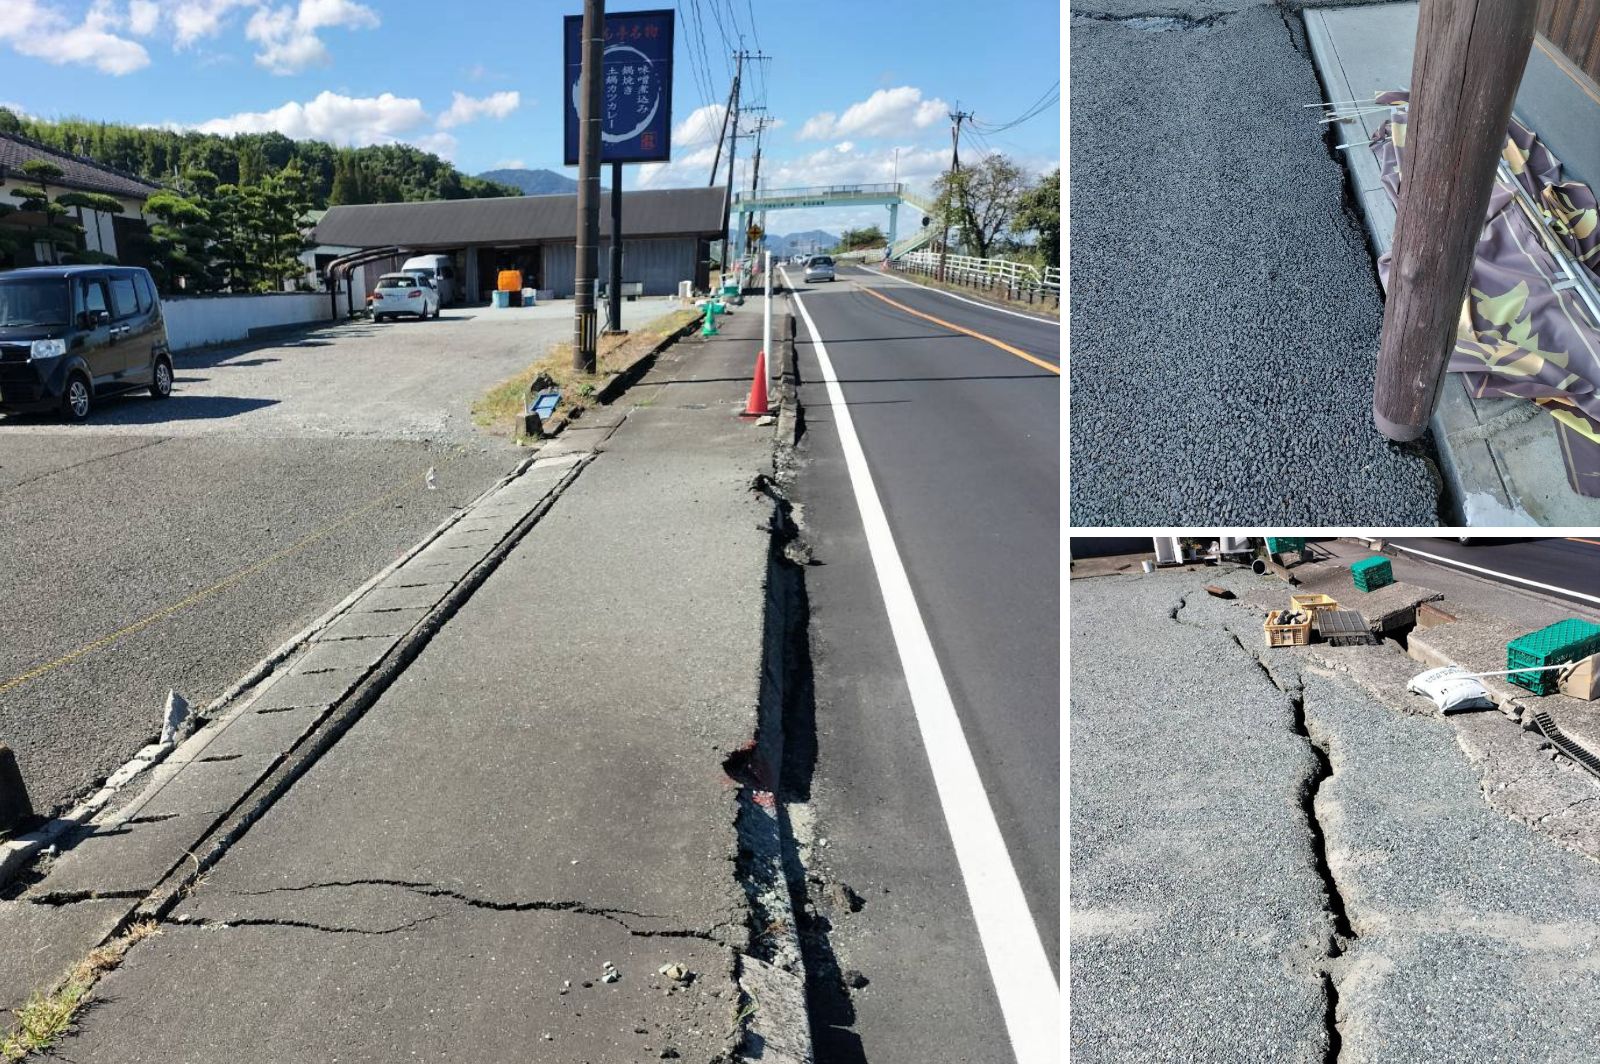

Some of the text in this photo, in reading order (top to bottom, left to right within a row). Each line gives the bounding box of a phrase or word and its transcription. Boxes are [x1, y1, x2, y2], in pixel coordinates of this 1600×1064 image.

[606, 67, 618, 129] 土鍋カツカレー
[622, 66, 634, 95] 鍋焼き
[637, 65, 649, 114] 味噌煮込み
